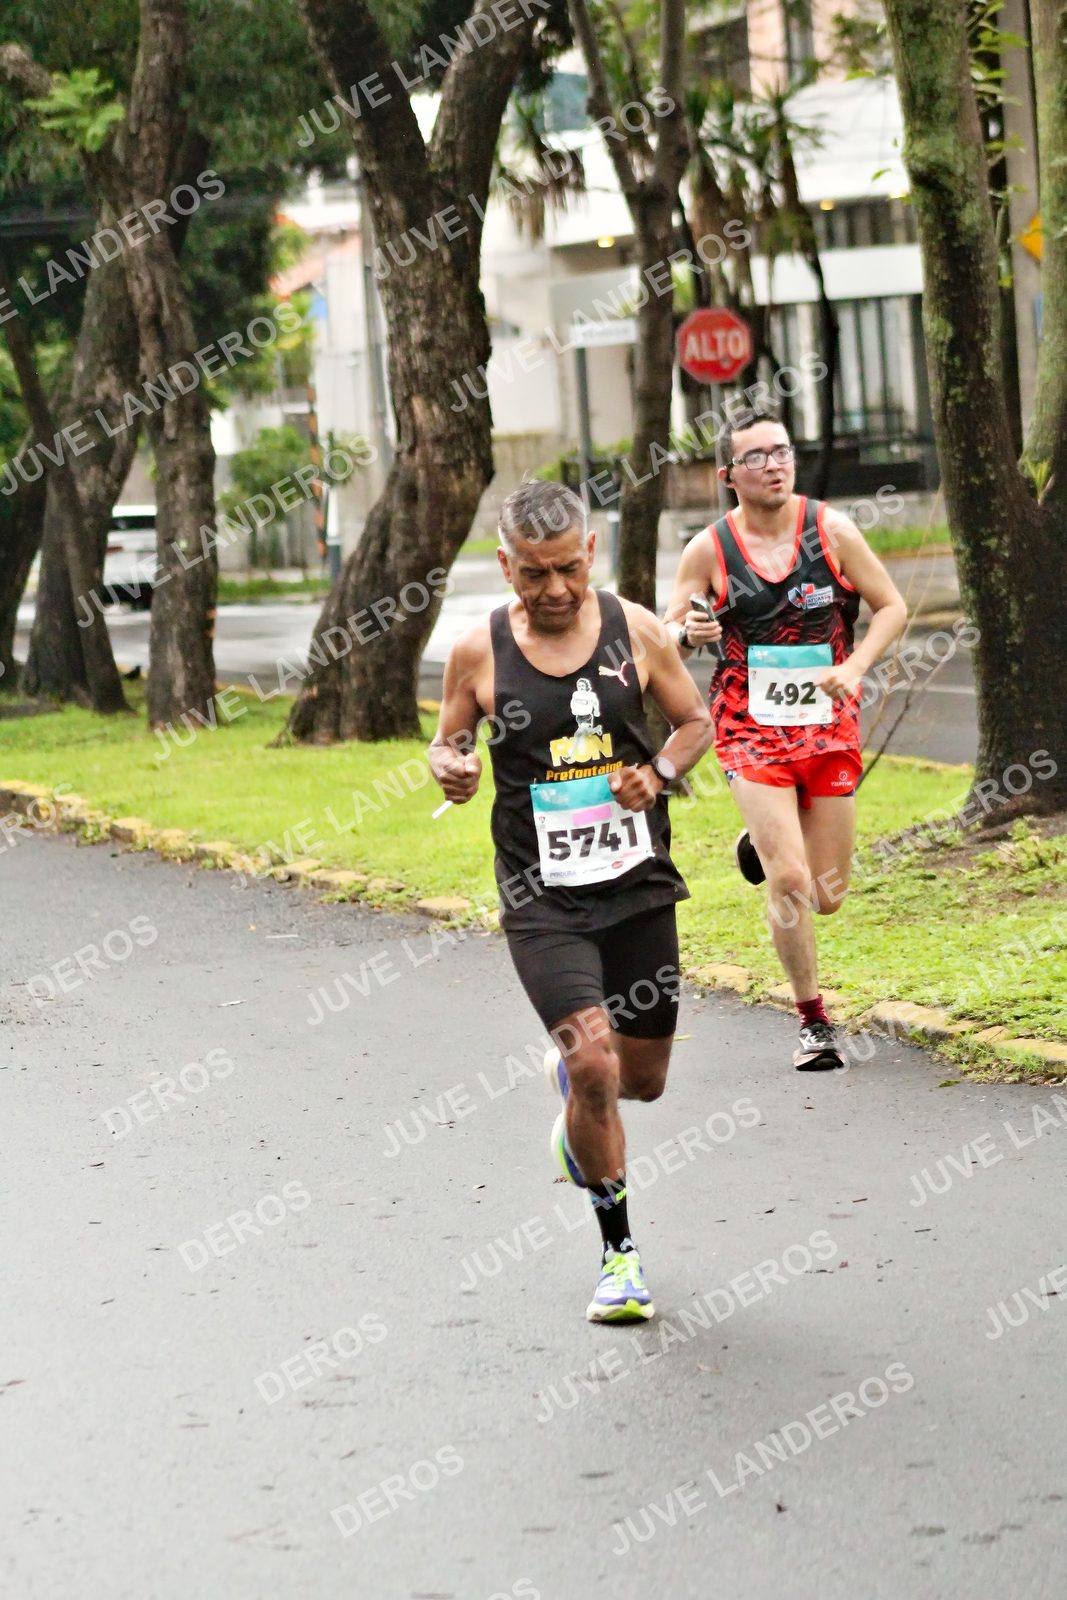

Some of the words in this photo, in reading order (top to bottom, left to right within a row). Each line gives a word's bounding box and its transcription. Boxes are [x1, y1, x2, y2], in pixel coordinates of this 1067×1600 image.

[684, 330, 746, 361] ALTO
[765, 681, 817, 706] 492
[550, 732, 613, 767] RUN
[547, 816, 638, 861] 5741
